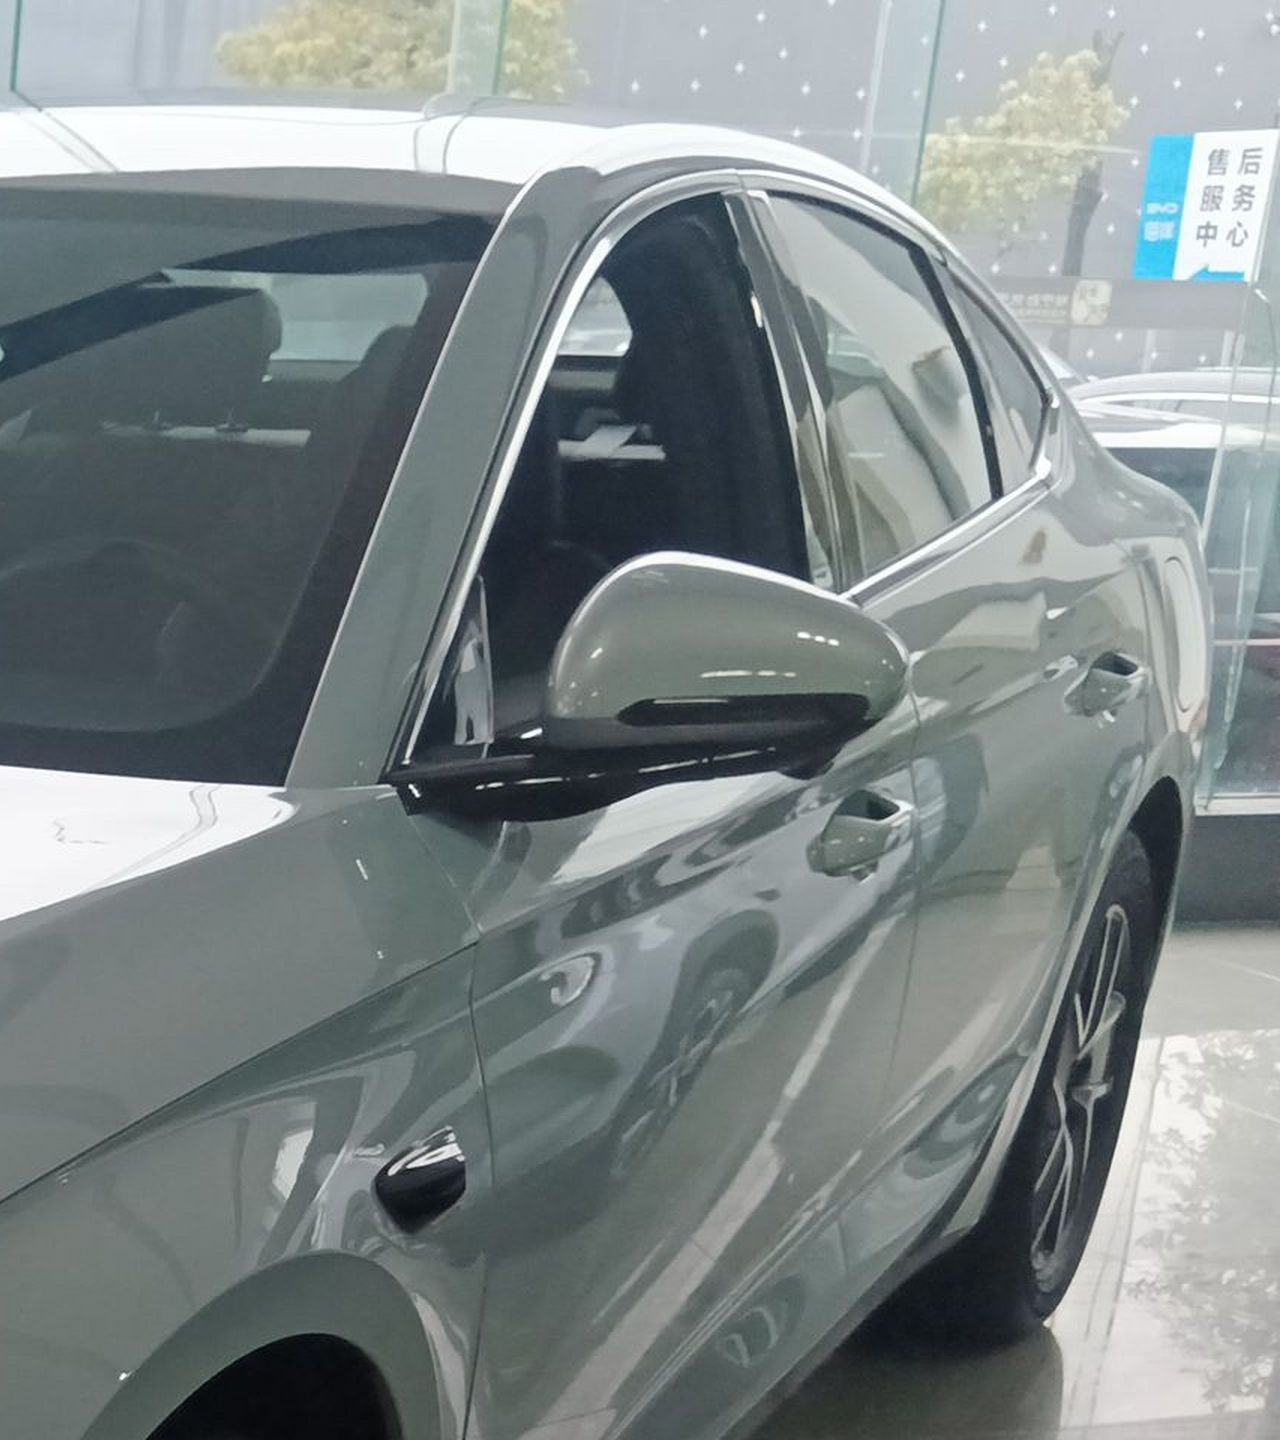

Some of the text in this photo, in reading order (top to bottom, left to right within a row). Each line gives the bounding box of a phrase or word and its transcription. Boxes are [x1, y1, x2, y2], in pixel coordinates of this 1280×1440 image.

[1206, 146, 1264, 176] 售后
[1199, 184, 1256, 213] 服务
[1196, 220, 1249, 248] 中心
